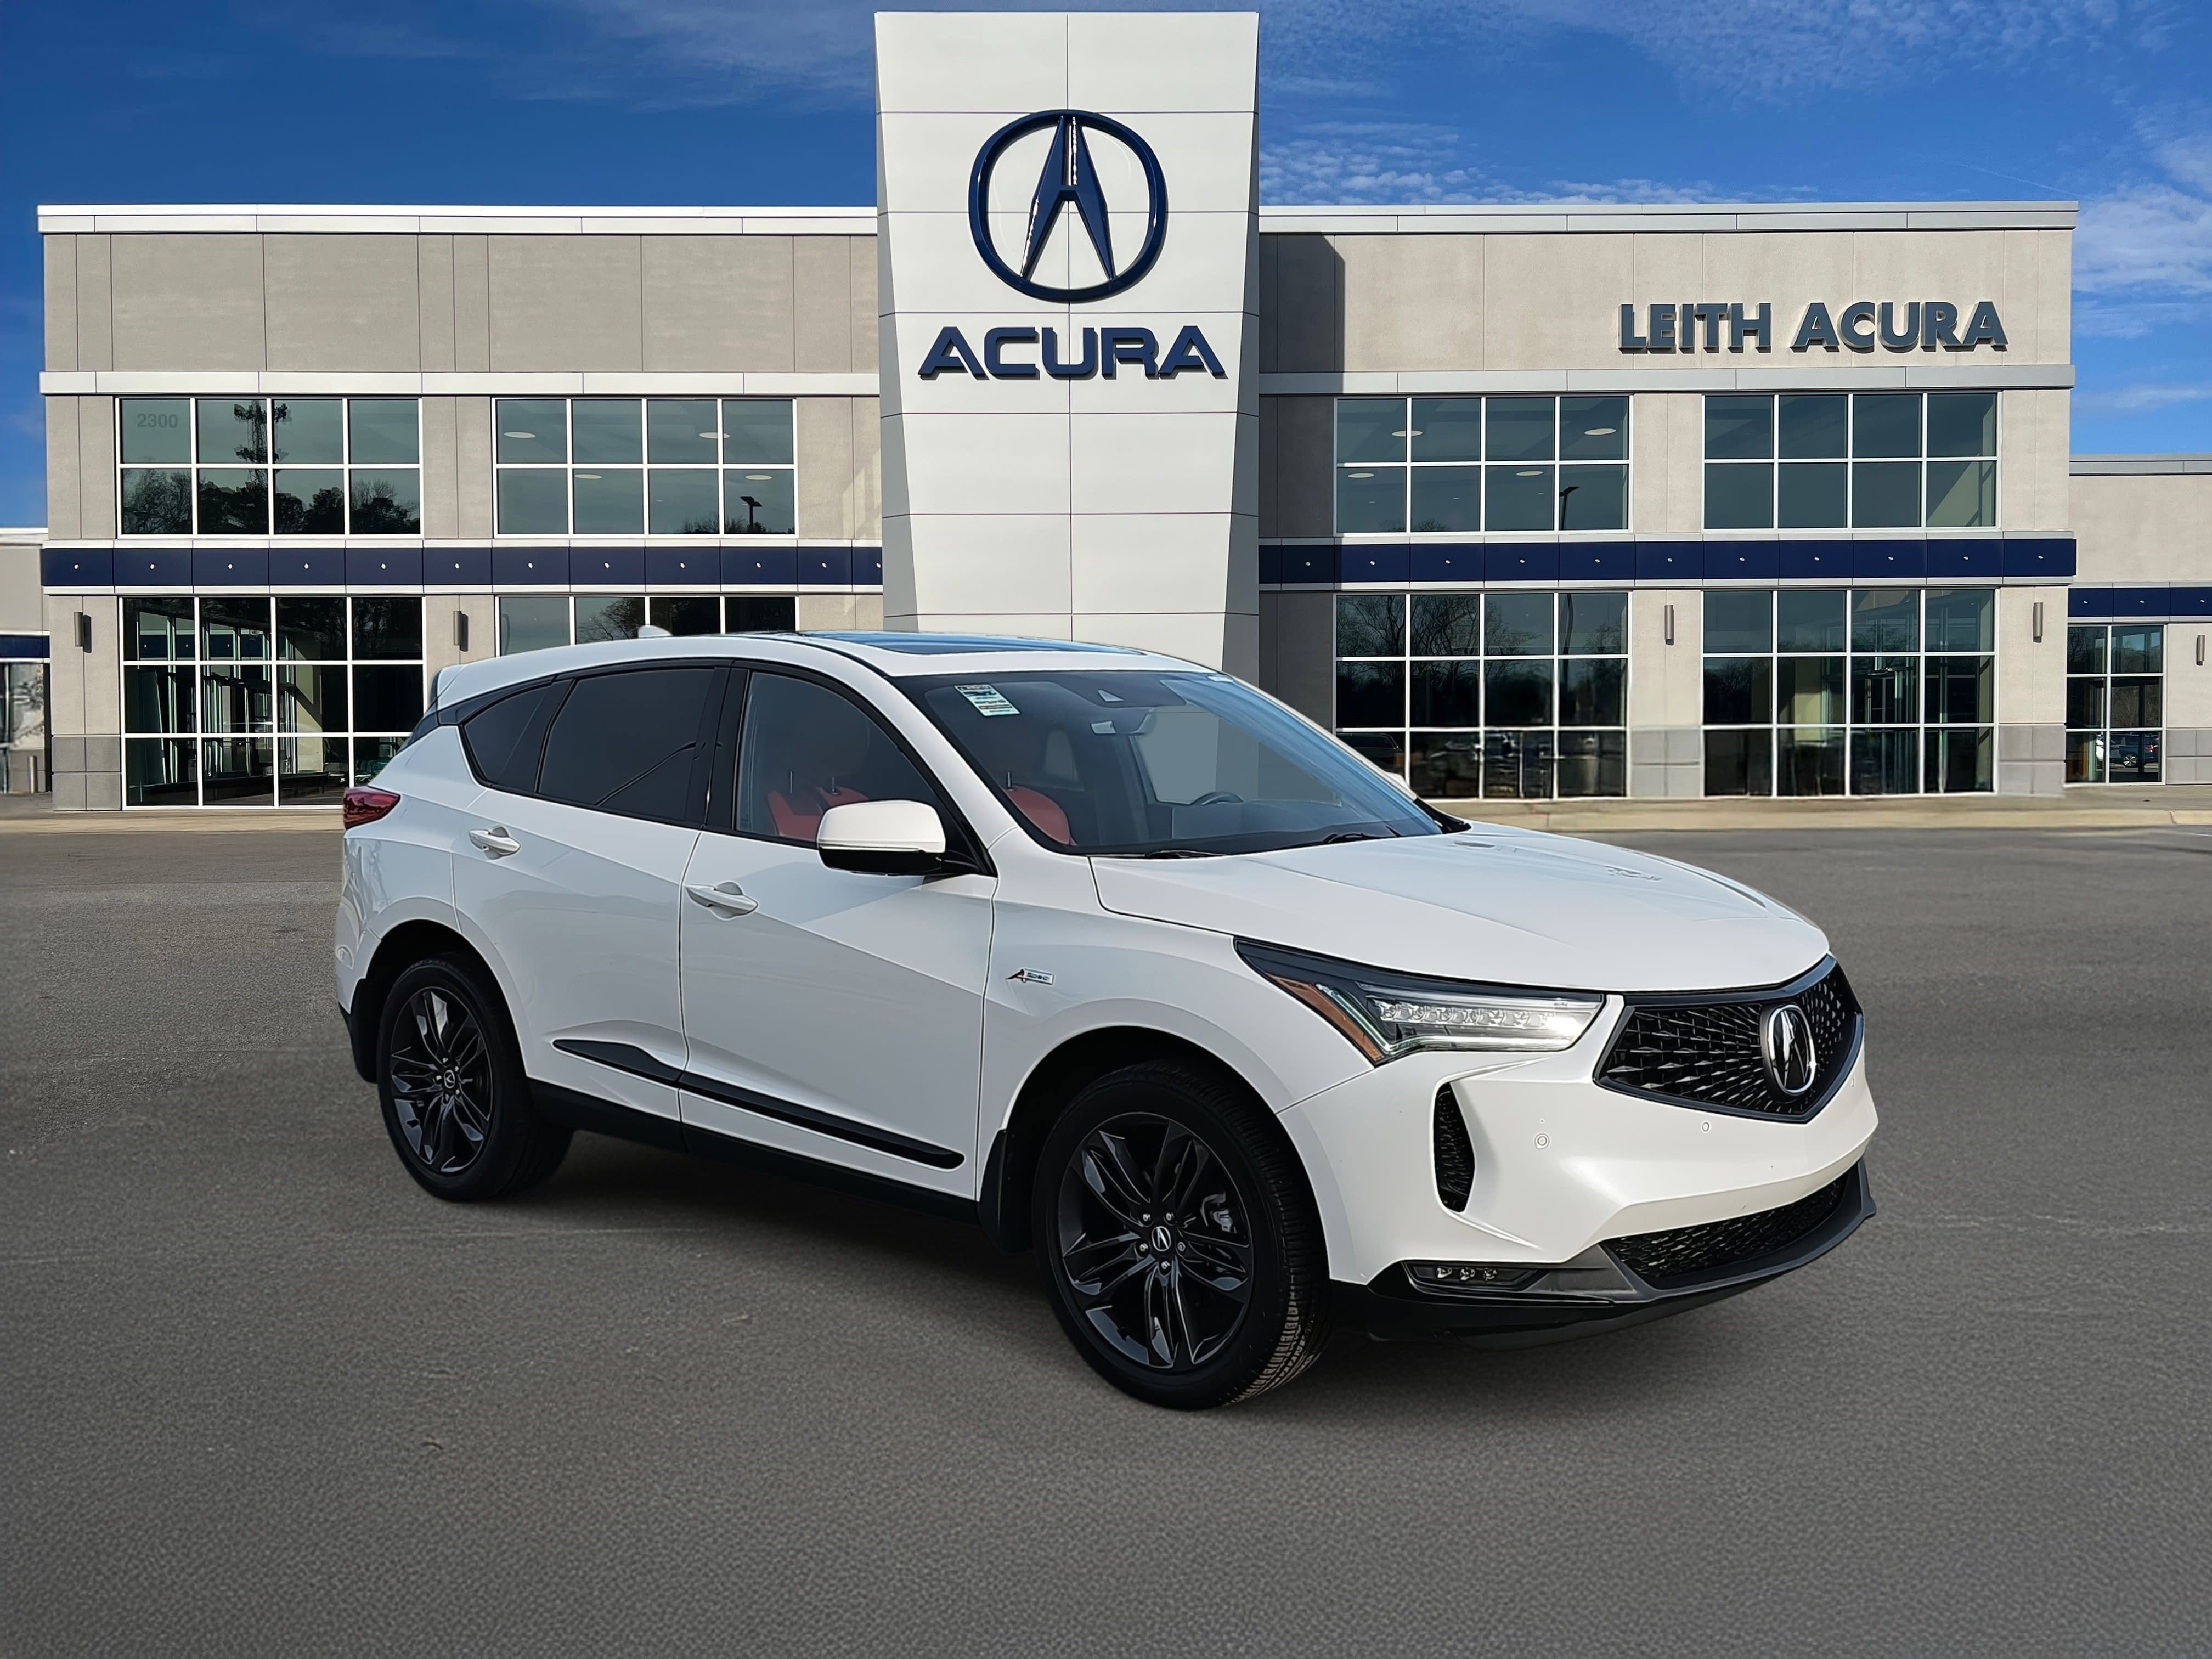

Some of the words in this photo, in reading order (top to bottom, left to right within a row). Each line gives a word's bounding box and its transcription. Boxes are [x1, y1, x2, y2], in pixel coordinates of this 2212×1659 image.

[917, 325, 1228, 379] ACURA
[1618, 303, 1771, 353] LEITH
[1790, 301, 2008, 353] ACURA
[137, 413, 178, 428] 2300
